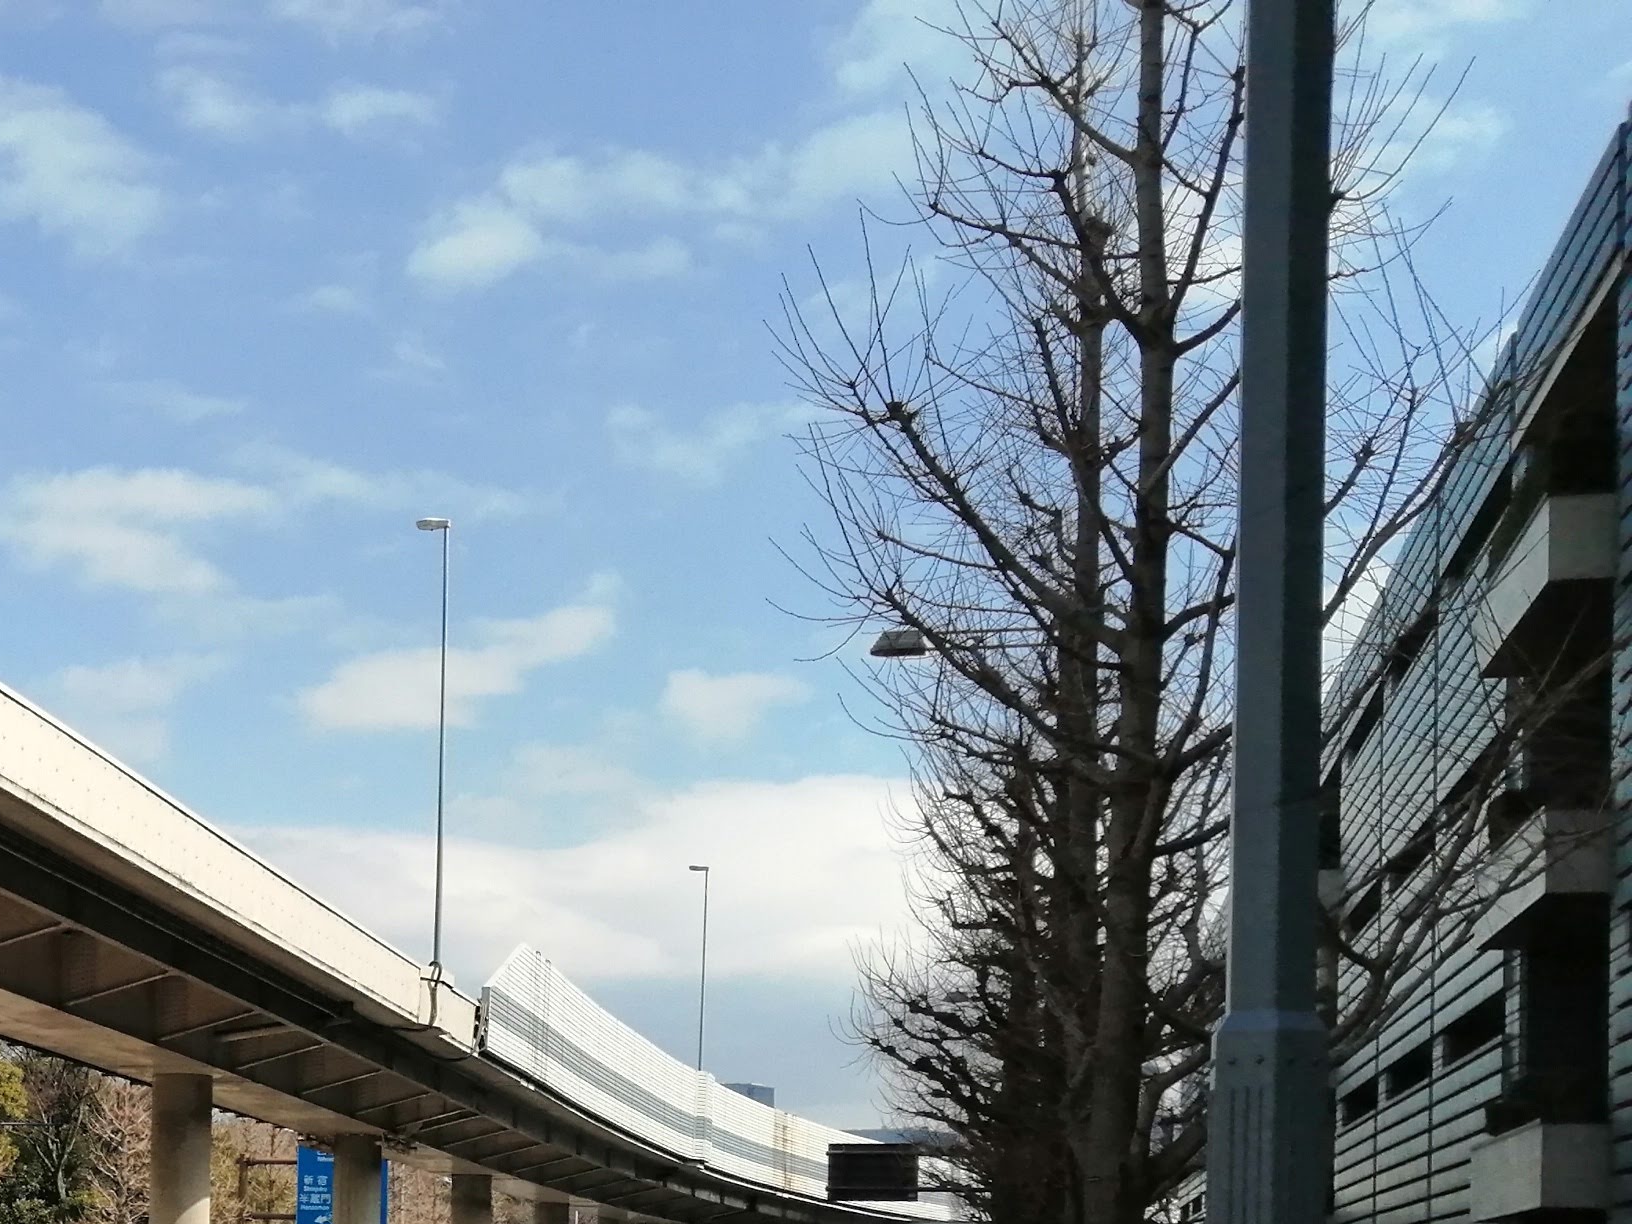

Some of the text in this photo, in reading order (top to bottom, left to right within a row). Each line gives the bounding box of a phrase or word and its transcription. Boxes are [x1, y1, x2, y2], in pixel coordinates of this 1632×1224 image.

[303, 1174, 328, 1186] 新宿
[299, 1193, 331, 1204] 半蔵門
